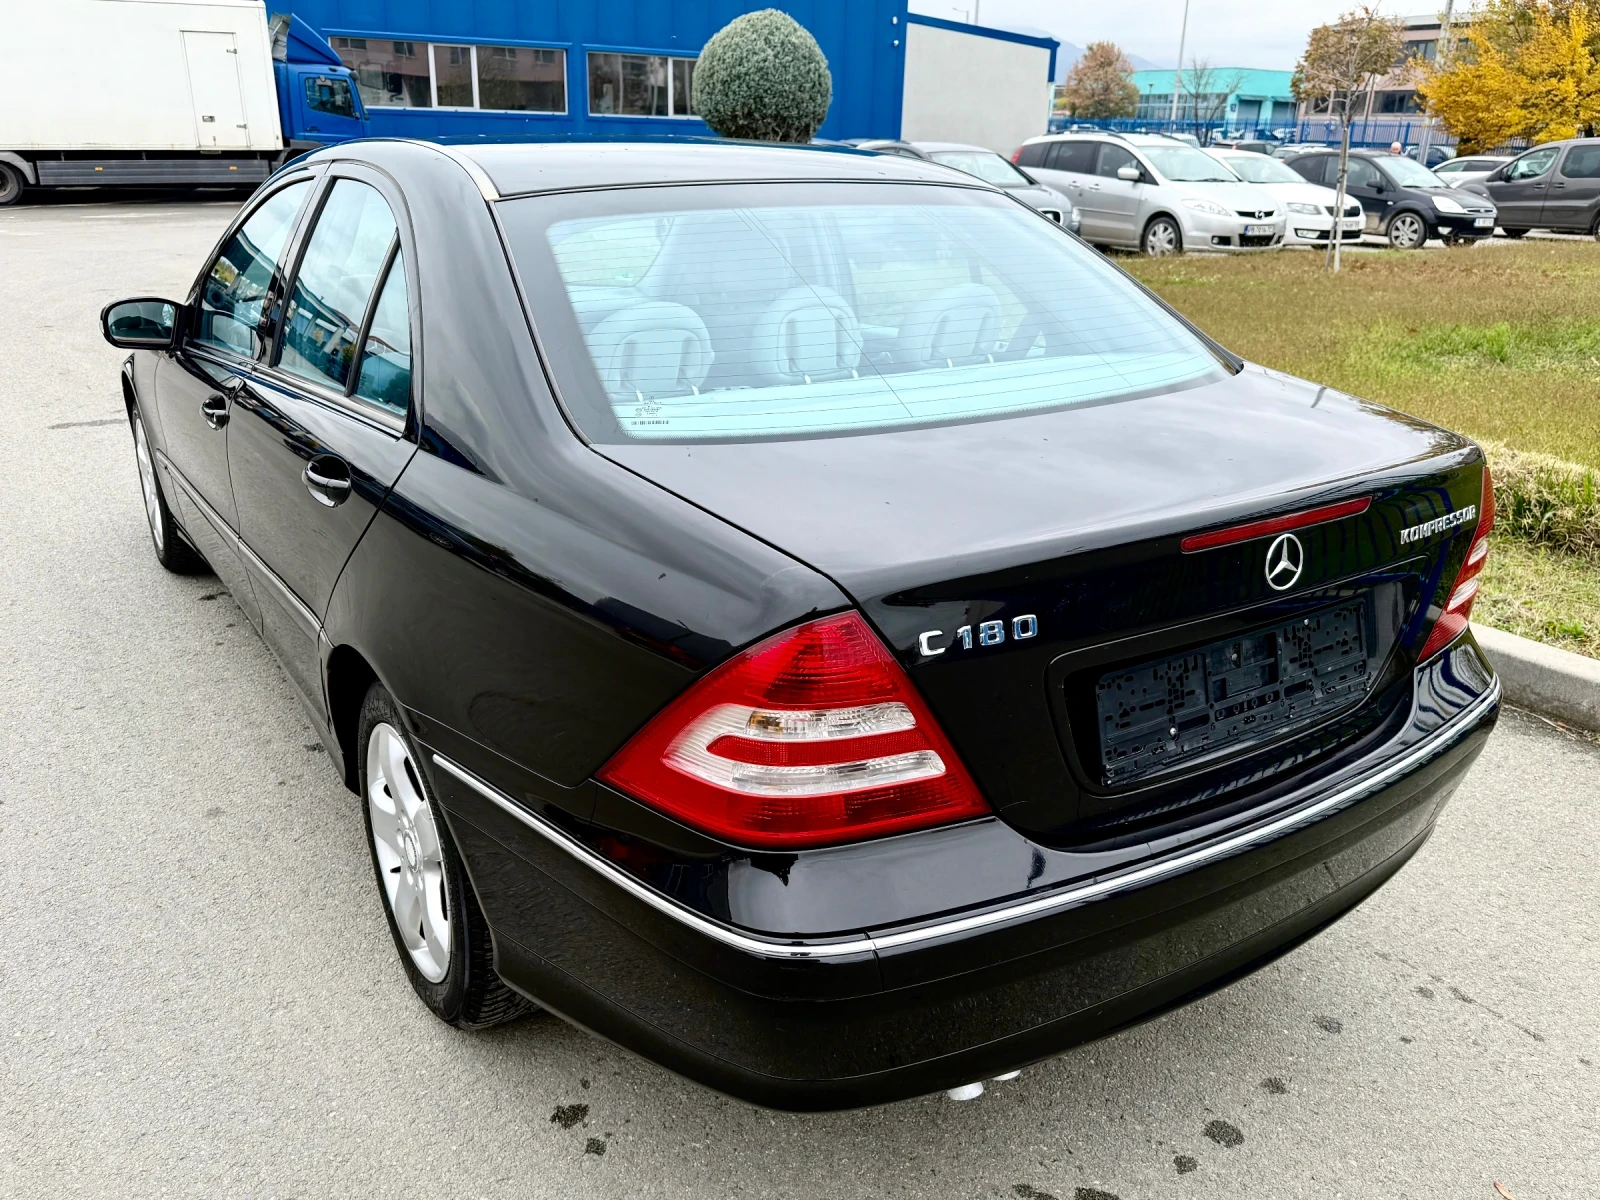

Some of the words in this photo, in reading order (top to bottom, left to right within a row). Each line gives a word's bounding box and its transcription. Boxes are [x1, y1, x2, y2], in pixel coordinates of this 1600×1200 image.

[1399, 504, 1477, 545] KOMPRESSOR
[918, 630, 946, 657] C
[957, 614, 1038, 650] 180
